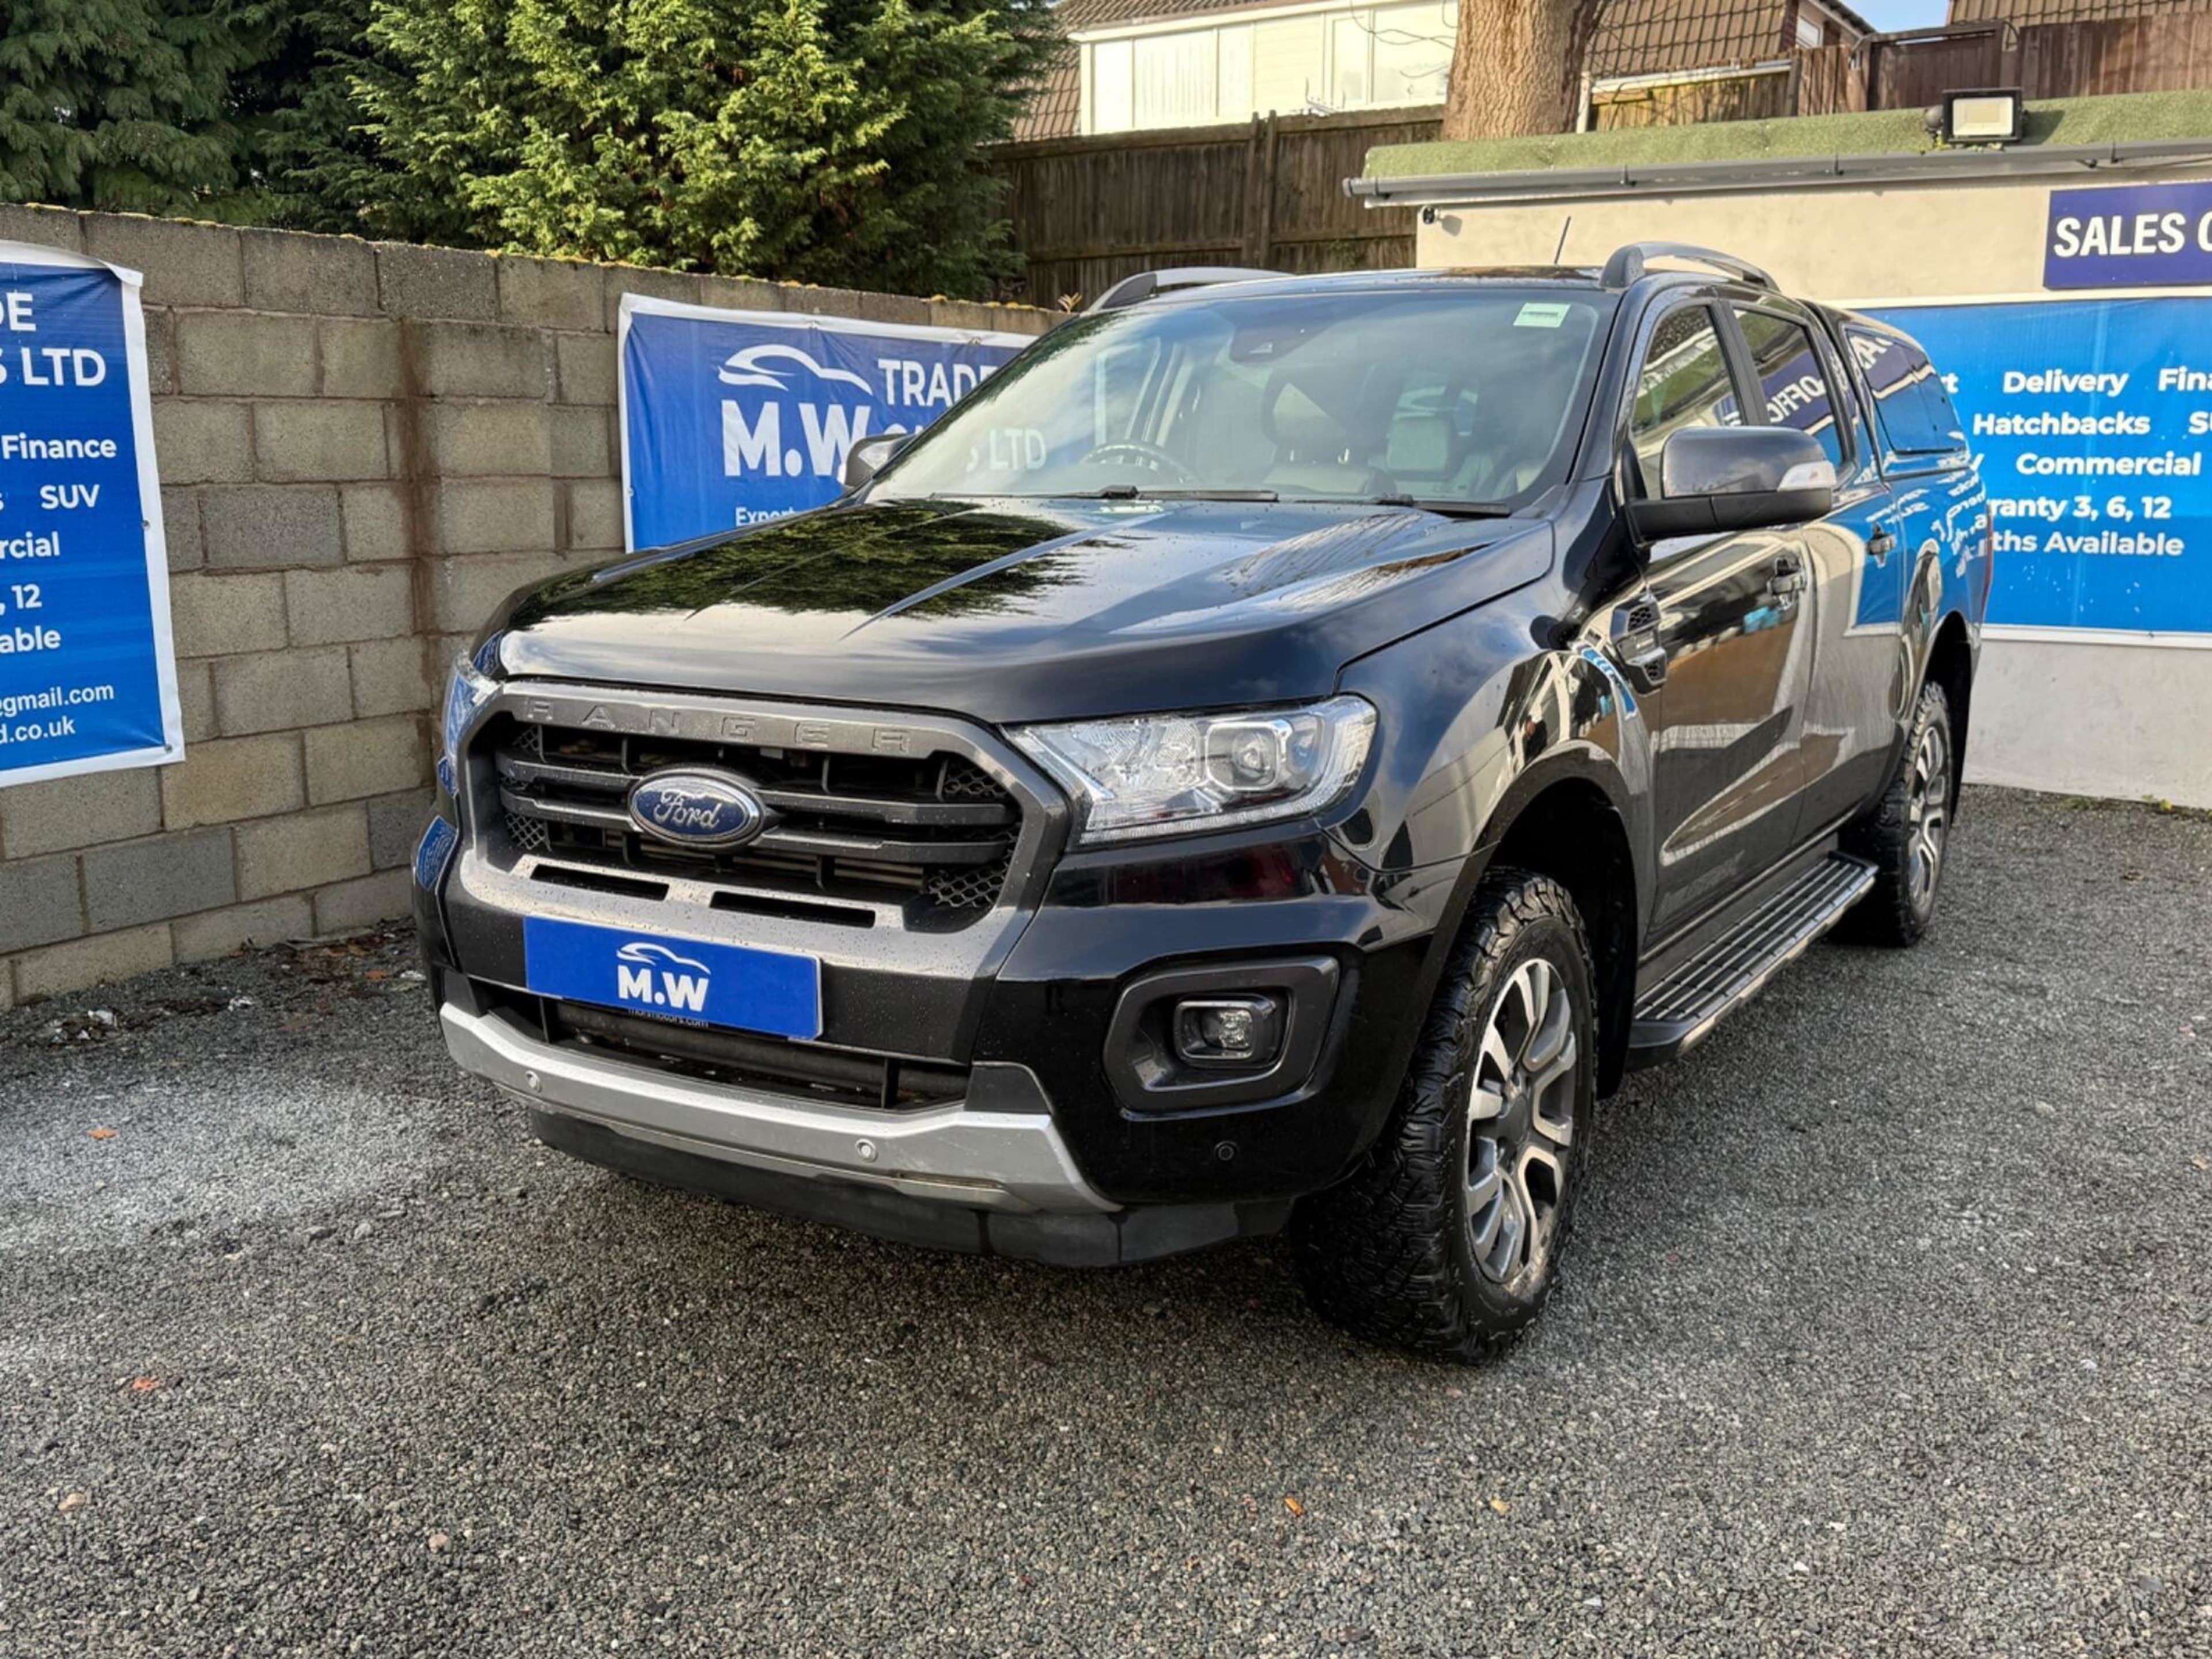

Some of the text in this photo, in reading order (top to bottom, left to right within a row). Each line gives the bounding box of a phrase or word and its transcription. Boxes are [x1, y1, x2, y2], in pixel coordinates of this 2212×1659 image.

[2053, 211, 2186, 257] SALES
[21, 347, 106, 387] LTD
[2003, 369, 2130, 397] Delivery
[2158, 365, 2212, 392] Fin
[721, 399, 872, 477] M.W
[1973, 411, 2151, 435] Hatchbacks
[1, 432, 117, 459] Finance
[988, 428, 1047, 471] LTD
[2016, 450, 2202, 476] Commercial
[40, 484, 100, 509] SUV
[1988, 495, 2172, 522] ranty 3, 6, 12
[2043, 531, 2185, 556] Available
[11, 584, 42, 609] 12
[0, 685, 114, 717] gmail.com
[526, 698, 912, 753] RANGER
[653, 788, 722, 830] Ford
[617, 964, 709, 1012] M.W
